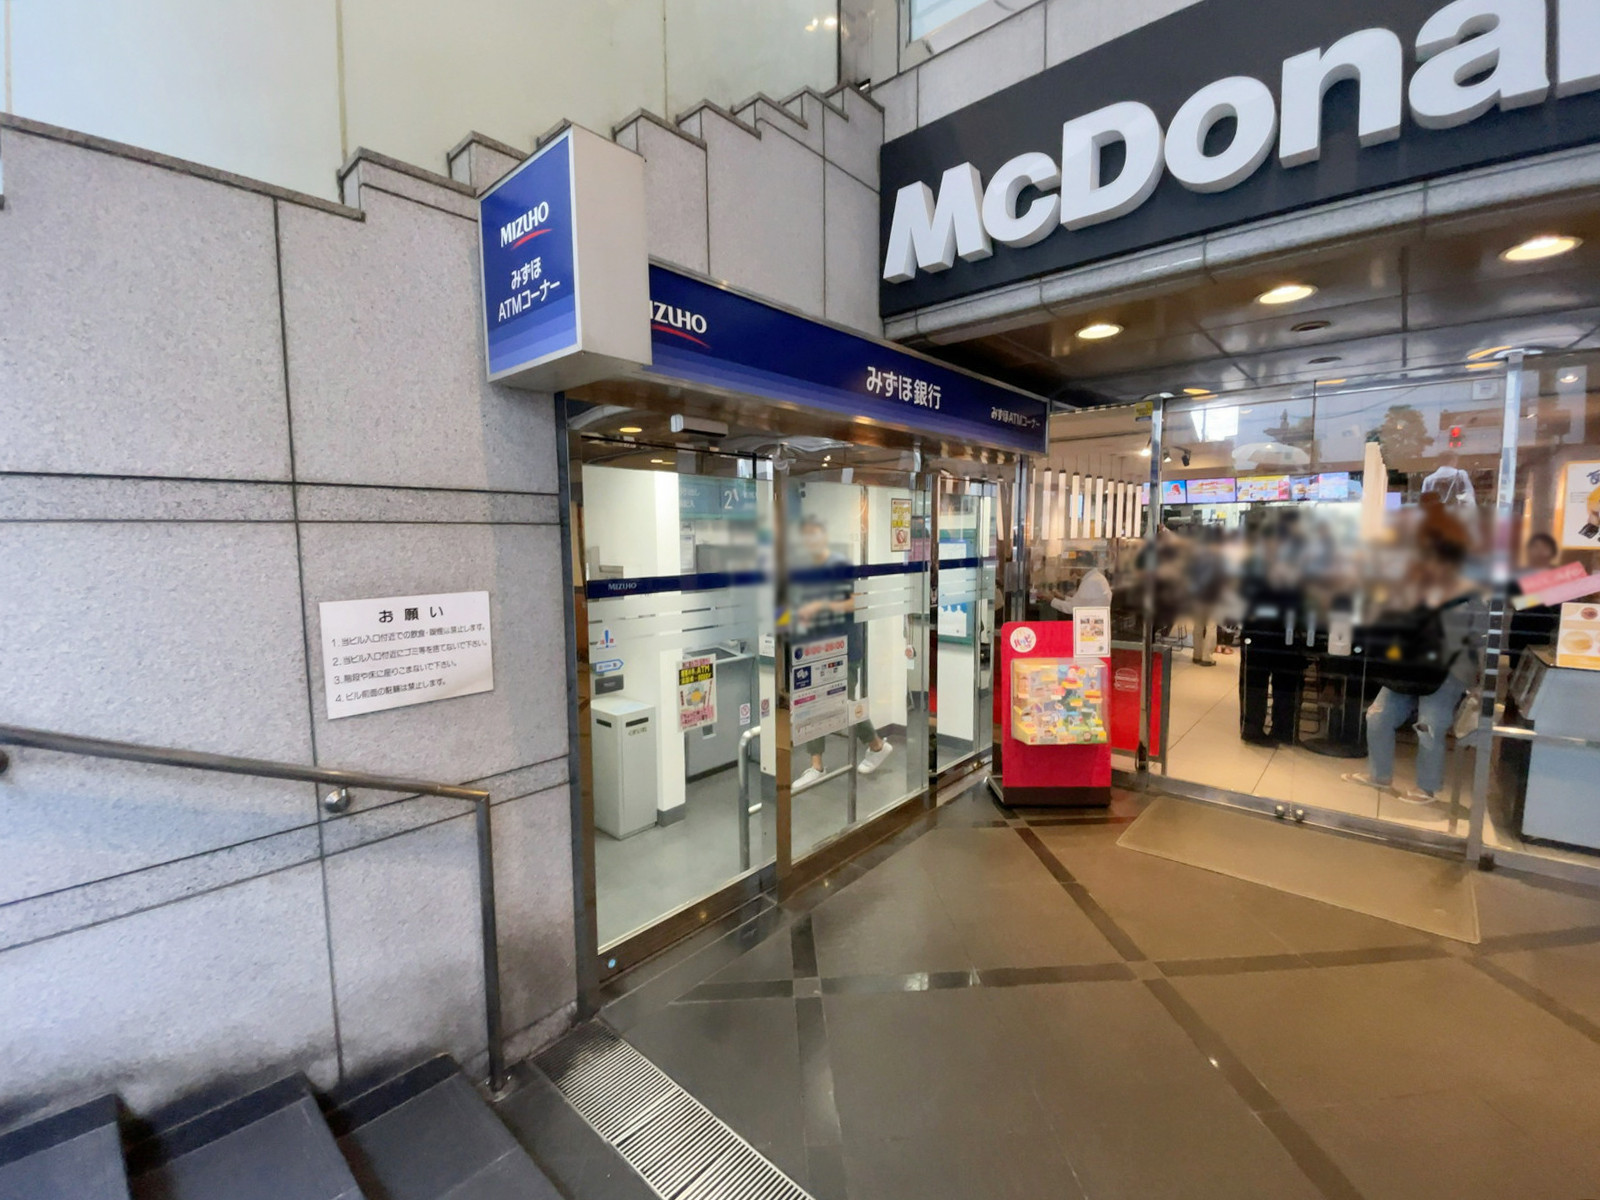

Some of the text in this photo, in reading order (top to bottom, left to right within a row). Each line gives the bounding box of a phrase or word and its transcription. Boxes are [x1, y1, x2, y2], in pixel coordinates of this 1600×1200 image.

[500, 201, 548, 247] MIZUHO
[511, 256, 542, 290] みずほ
[498, 279, 560, 322] ATMコーナー
[649, 300, 708, 334] IZUHO
[866, 365, 942, 410] みずほ銀行
[990, 406, 1041, 428] みずほATMコーナー
[608, 582, 637, 590] MIZUHO
[378, 606, 445, 624] お願い
